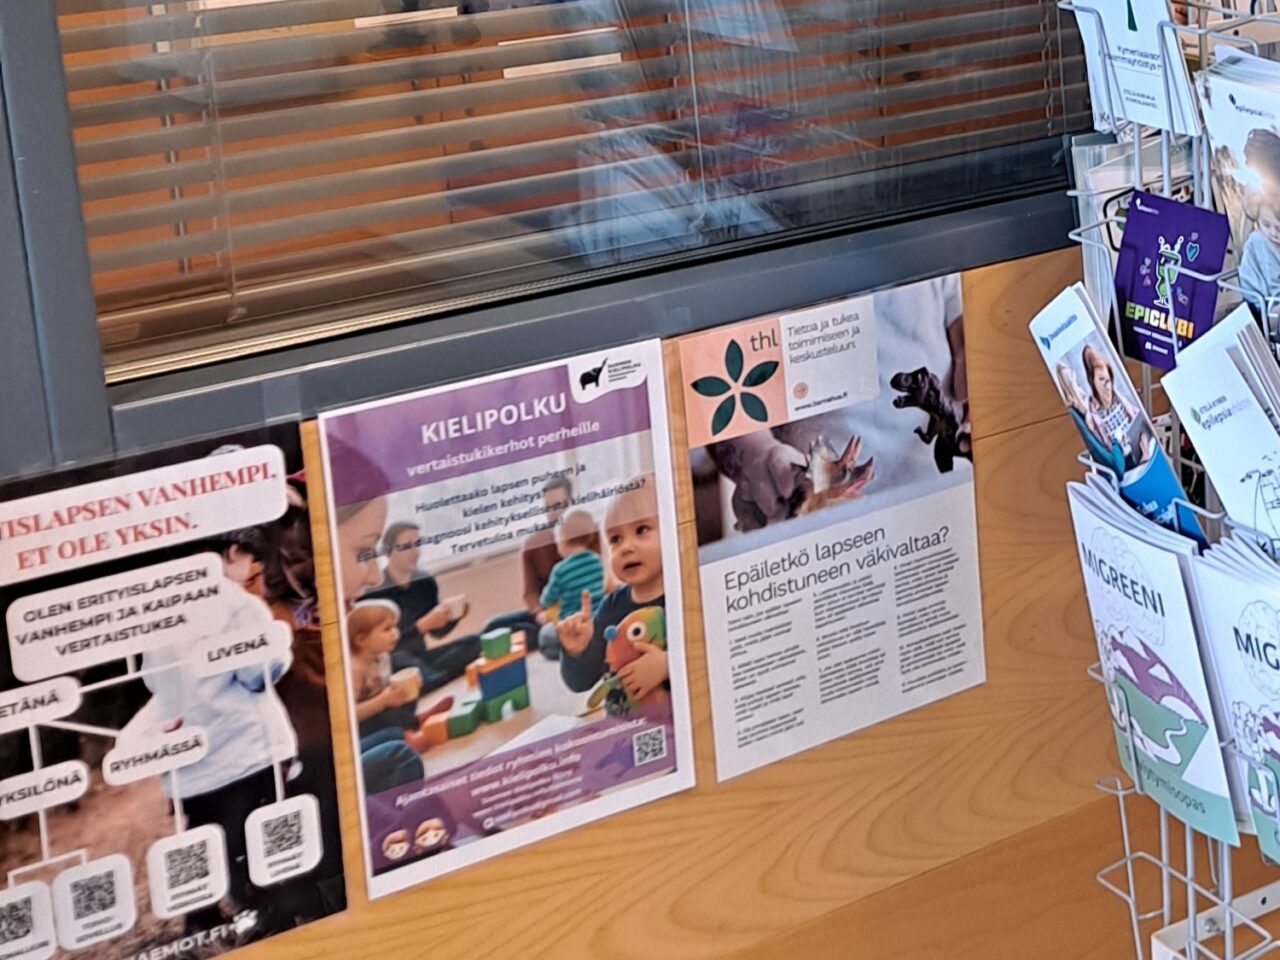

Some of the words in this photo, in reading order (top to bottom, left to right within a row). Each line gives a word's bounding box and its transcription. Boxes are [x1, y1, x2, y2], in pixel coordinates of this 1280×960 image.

[750, 328, 778, 352] thl
[787, 323, 818, 337] Tietoa
[820, 320, 830, 333] ja
[832, 312, 860, 326] tukea
[788, 328, 851, 351] toimimiseen
[852, 325, 860, 339] ja
[421, 392, 567, 445] KIELIPOLKU
[406, 436, 535, 477] vertaistukikerhot
[538, 420, 600, 449] perheille
[137, 461, 277, 508] VANHEMPI.
[415, 487, 489, 514] Huolettaako
[491, 478, 529, 496] lapsen
[532, 469, 572, 488] puheen
[574, 462, 587, 478] ja
[570, 478, 646, 508] kielihäiriöstä?
[462, 502, 498, 518] kielen
[16, 545, 50, 571] ET
[57, 531, 111, 561] OLE
[114, 512, 199, 546] YKSIN.
[450, 531, 514, 555] Tervetuloa
[516, 517, 564, 540] mukaan!
[724, 548, 810, 591] Epäiletkö
[815, 527, 886, 563] lapseen
[726, 560, 851, 614] kohdistuneen
[856, 525, 950, 571] väkivaltaa?
[1081, 542, 1166, 617] MIGREENI
[15, 613, 115, 647] VANHEMPI
[116, 607, 137, 622] JA
[141, 584, 220, 614] KAIPAAN
[23, 601, 71, 624] OLEN
[78, 566, 209, 611] ERITYISLAPSEN
[55, 614, 187, 657] VERTAISTUKEA
[208, 634, 269, 663] LIVENÄ
[110, 735, 202, 774] RYHMÄSSÄ
